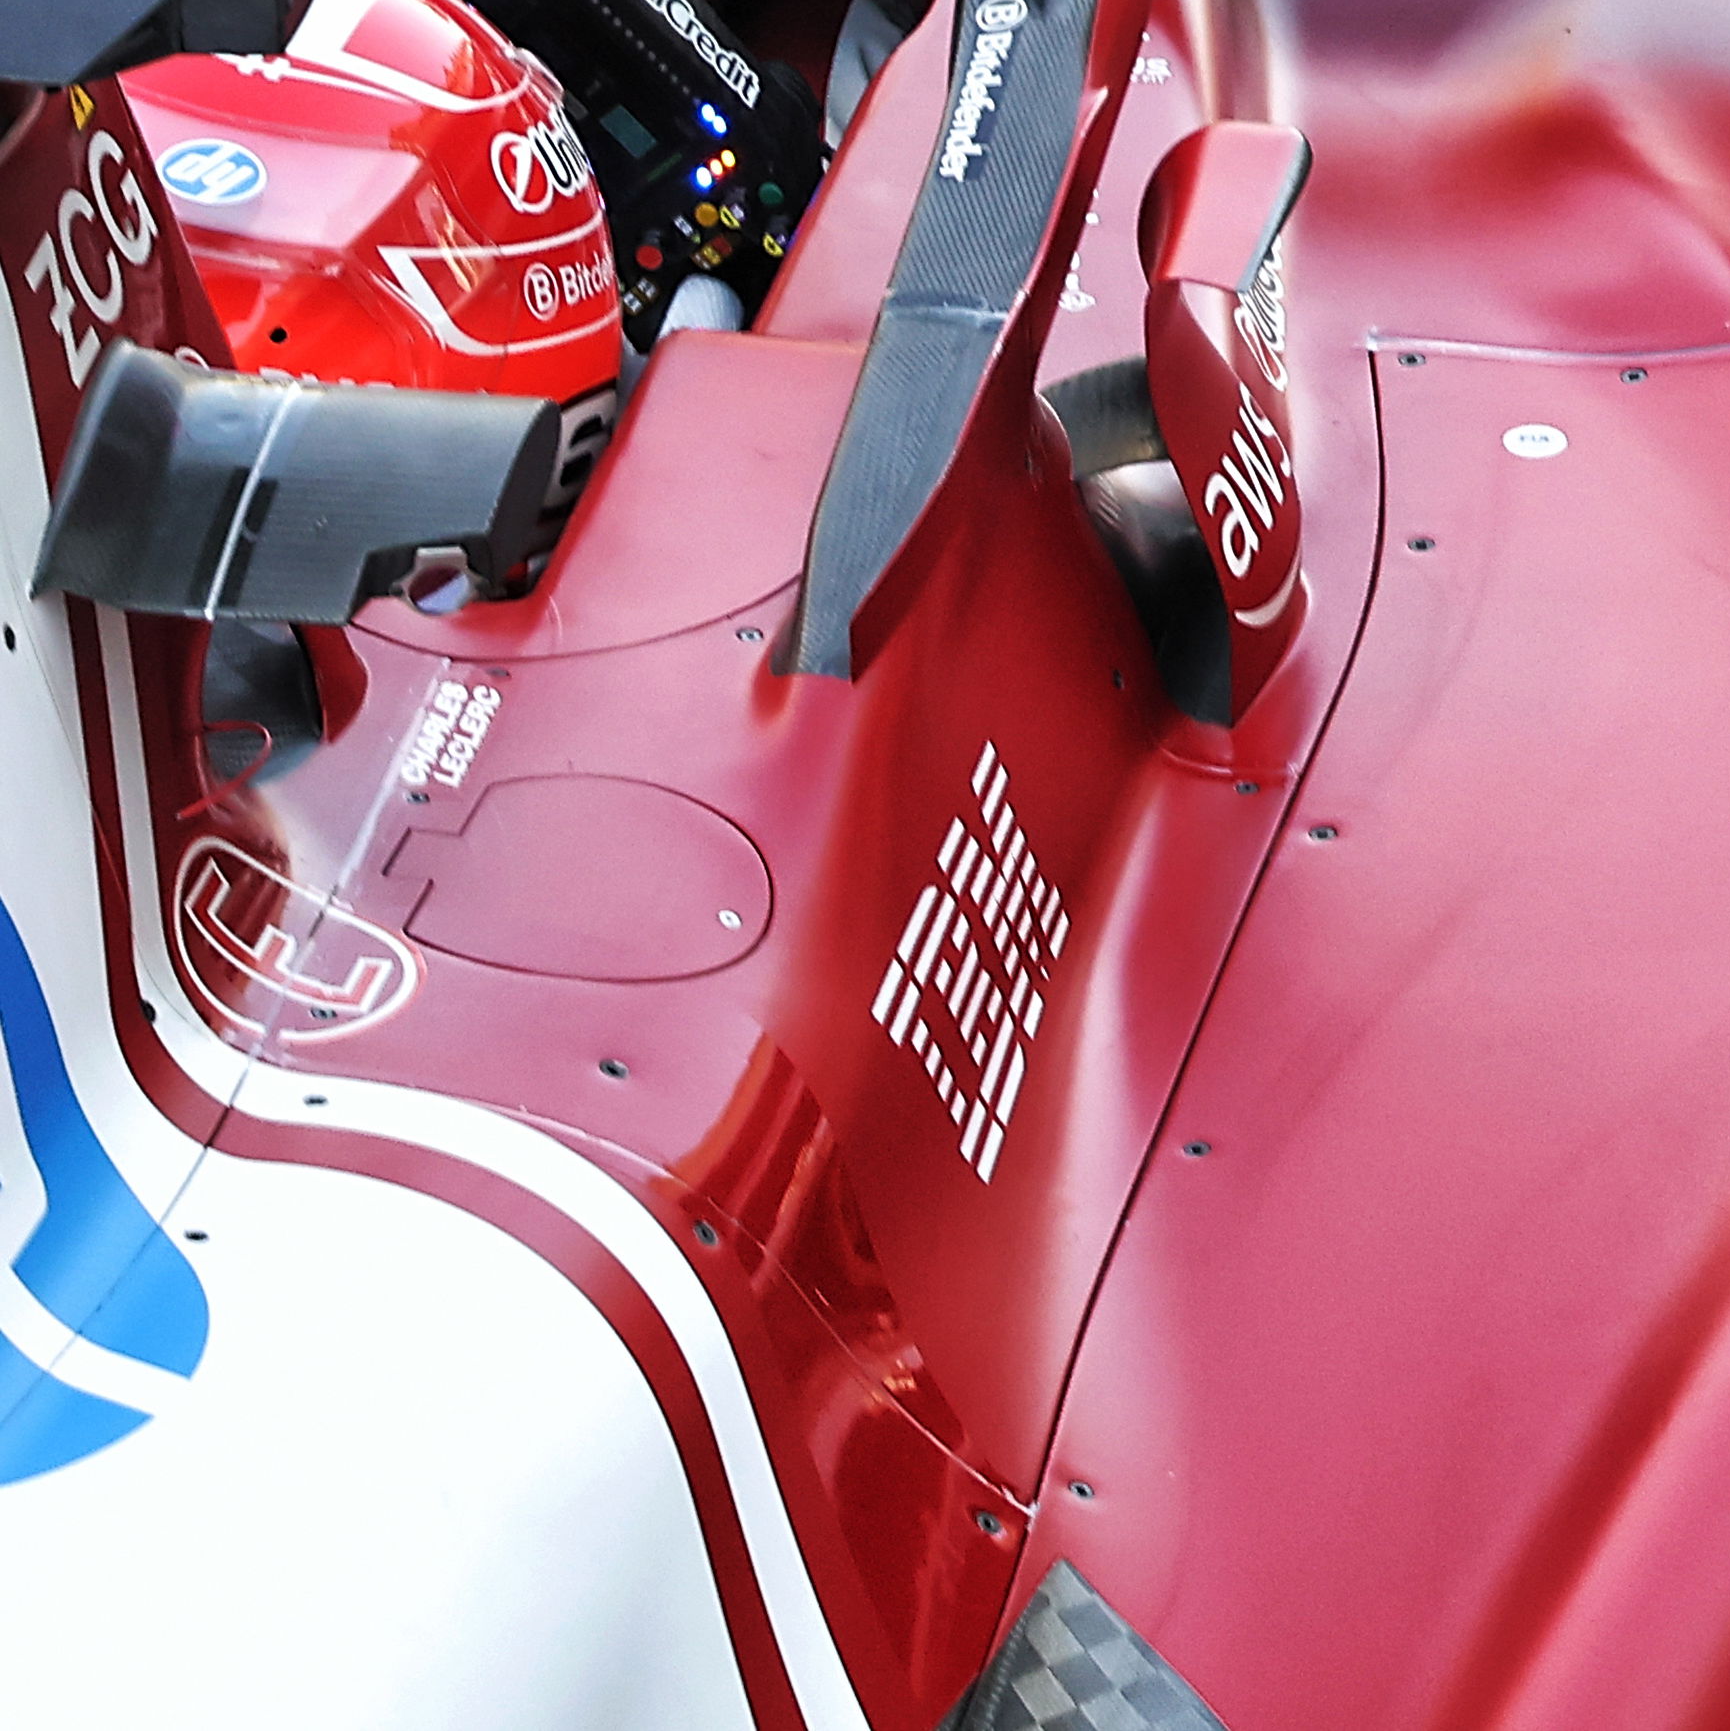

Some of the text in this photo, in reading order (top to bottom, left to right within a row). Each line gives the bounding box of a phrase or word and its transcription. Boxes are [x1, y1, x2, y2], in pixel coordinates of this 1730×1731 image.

[939, 31, 1013, 182] Bitdefender
[26, 131, 158, 388] ZCG
[1205, 380, 1292, 576] aws
[400, 680, 470, 785] CHARLES
[438, 684, 502, 787] LECLERC
[871, 740, 1069, 1185] IBM
